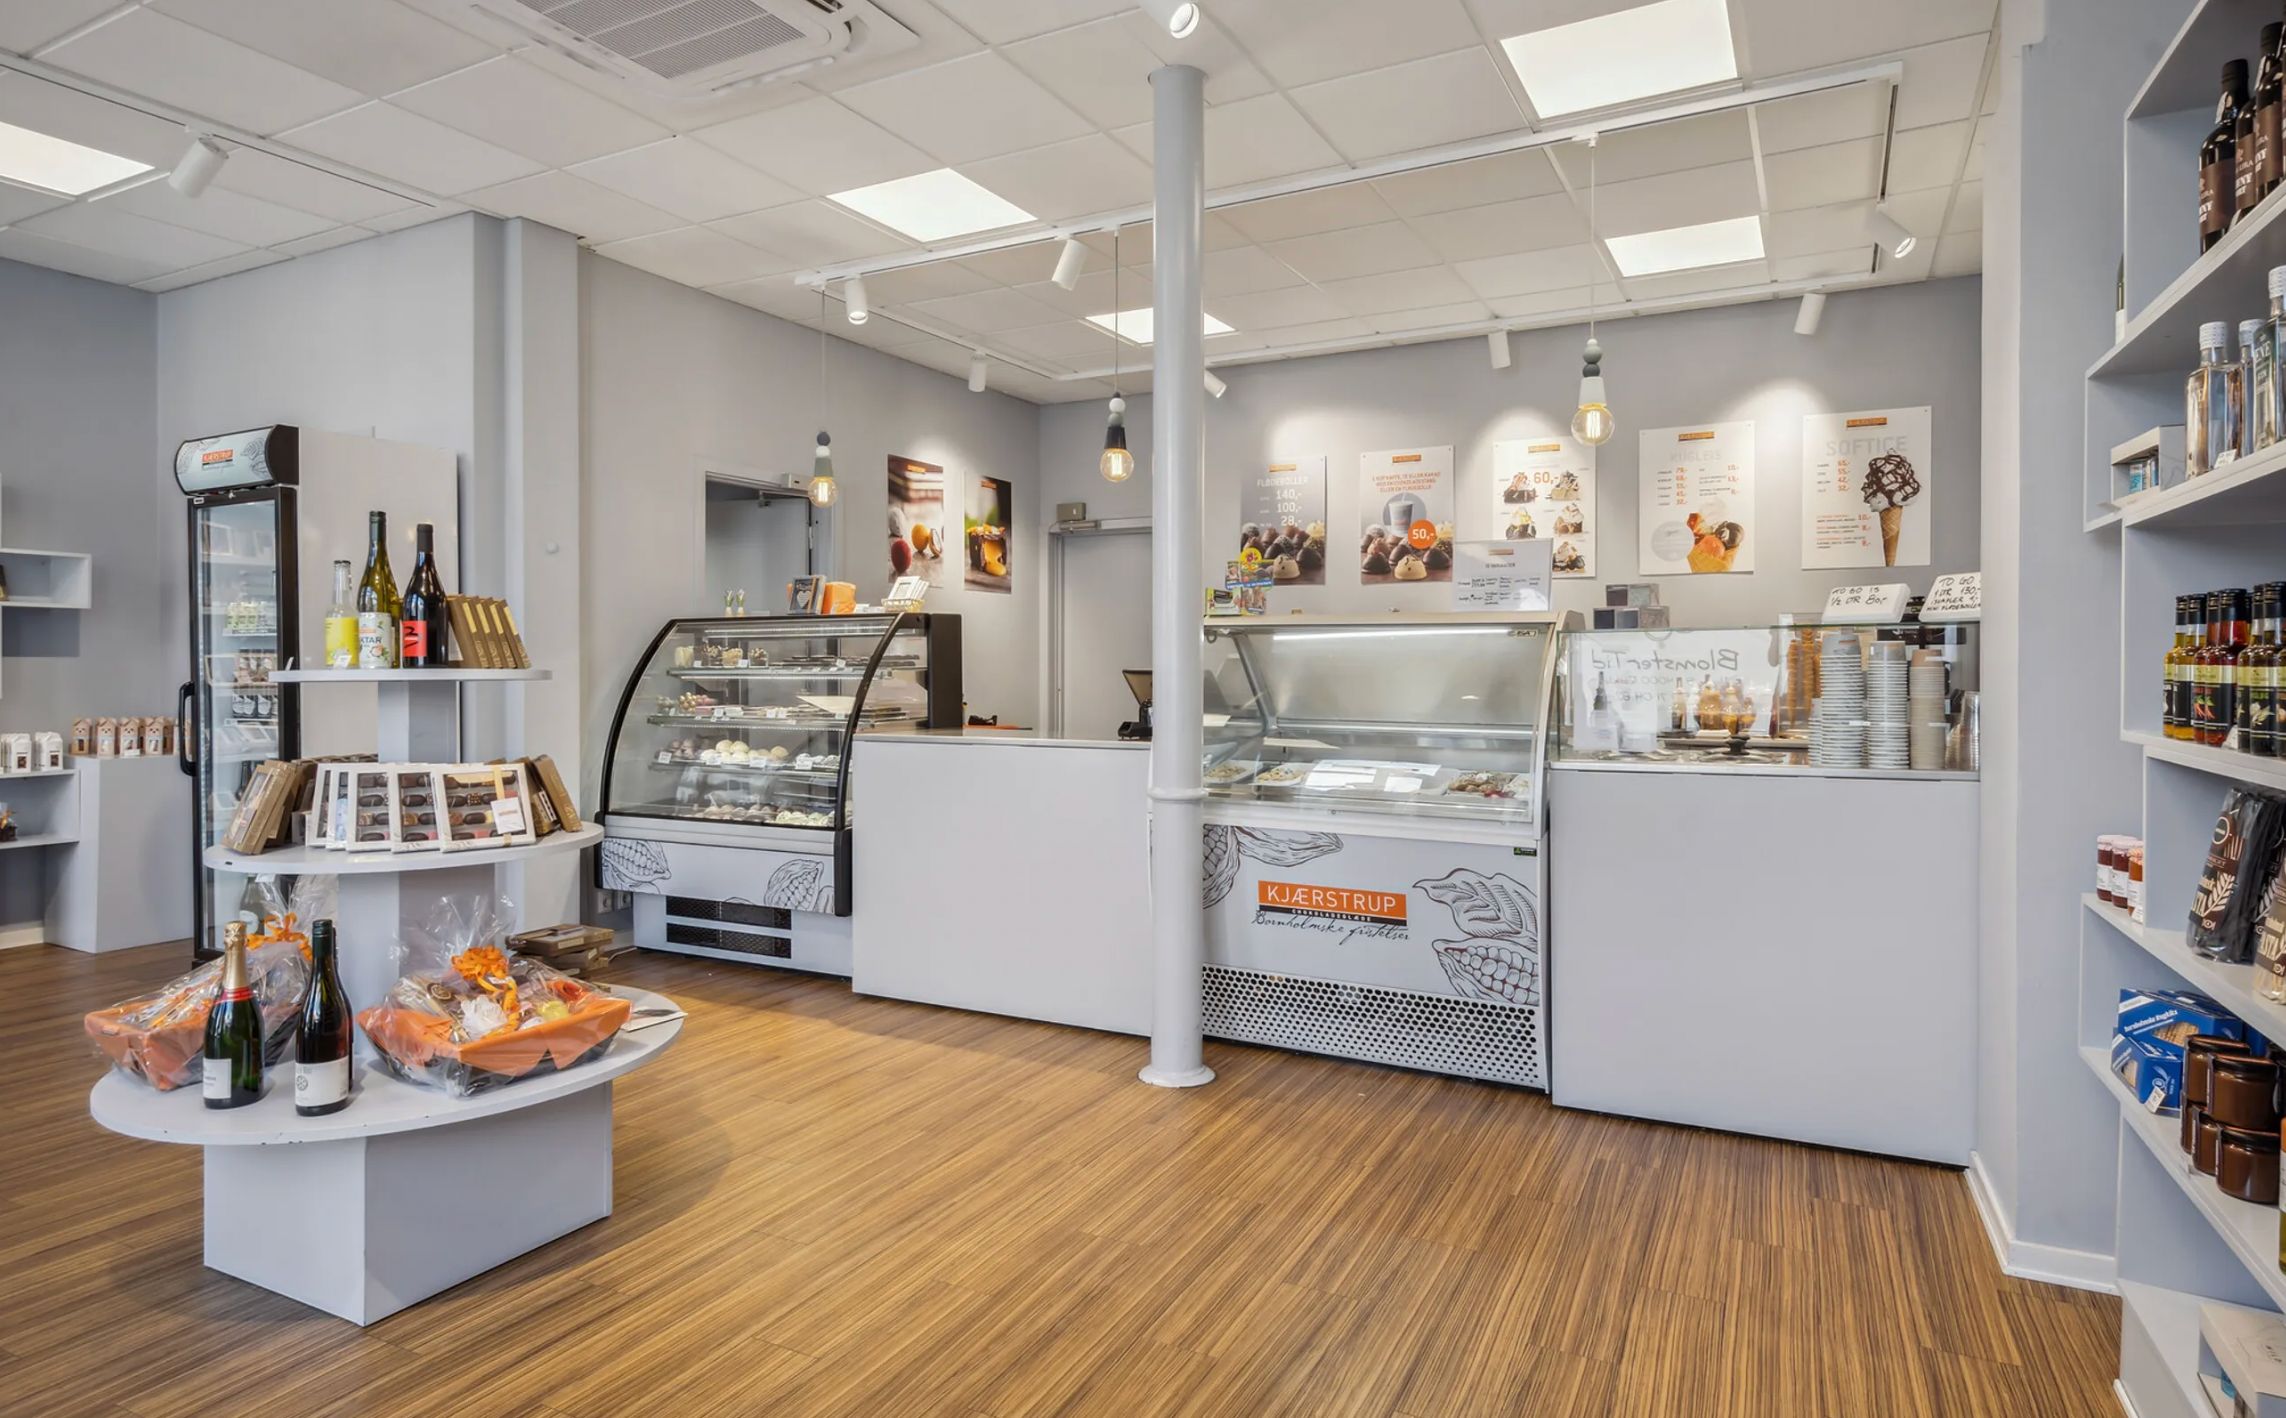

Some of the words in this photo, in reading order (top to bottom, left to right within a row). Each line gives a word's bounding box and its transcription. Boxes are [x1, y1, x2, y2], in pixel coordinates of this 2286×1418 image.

[1826, 435, 1908, 456] SOFTICE
[1533, 471, 1559, 485] 60,-
[1276, 488, 1302, 500] 140,-
[1277, 502, 1302, 514] 100,-
[1280, 515, 1302, 527] 28,-
[1412, 528, 1434, 540] 50,-
[1267, 886, 1396, 913] KJÆRSTRUP
[1251, 909, 1345, 933] Bornholmske
